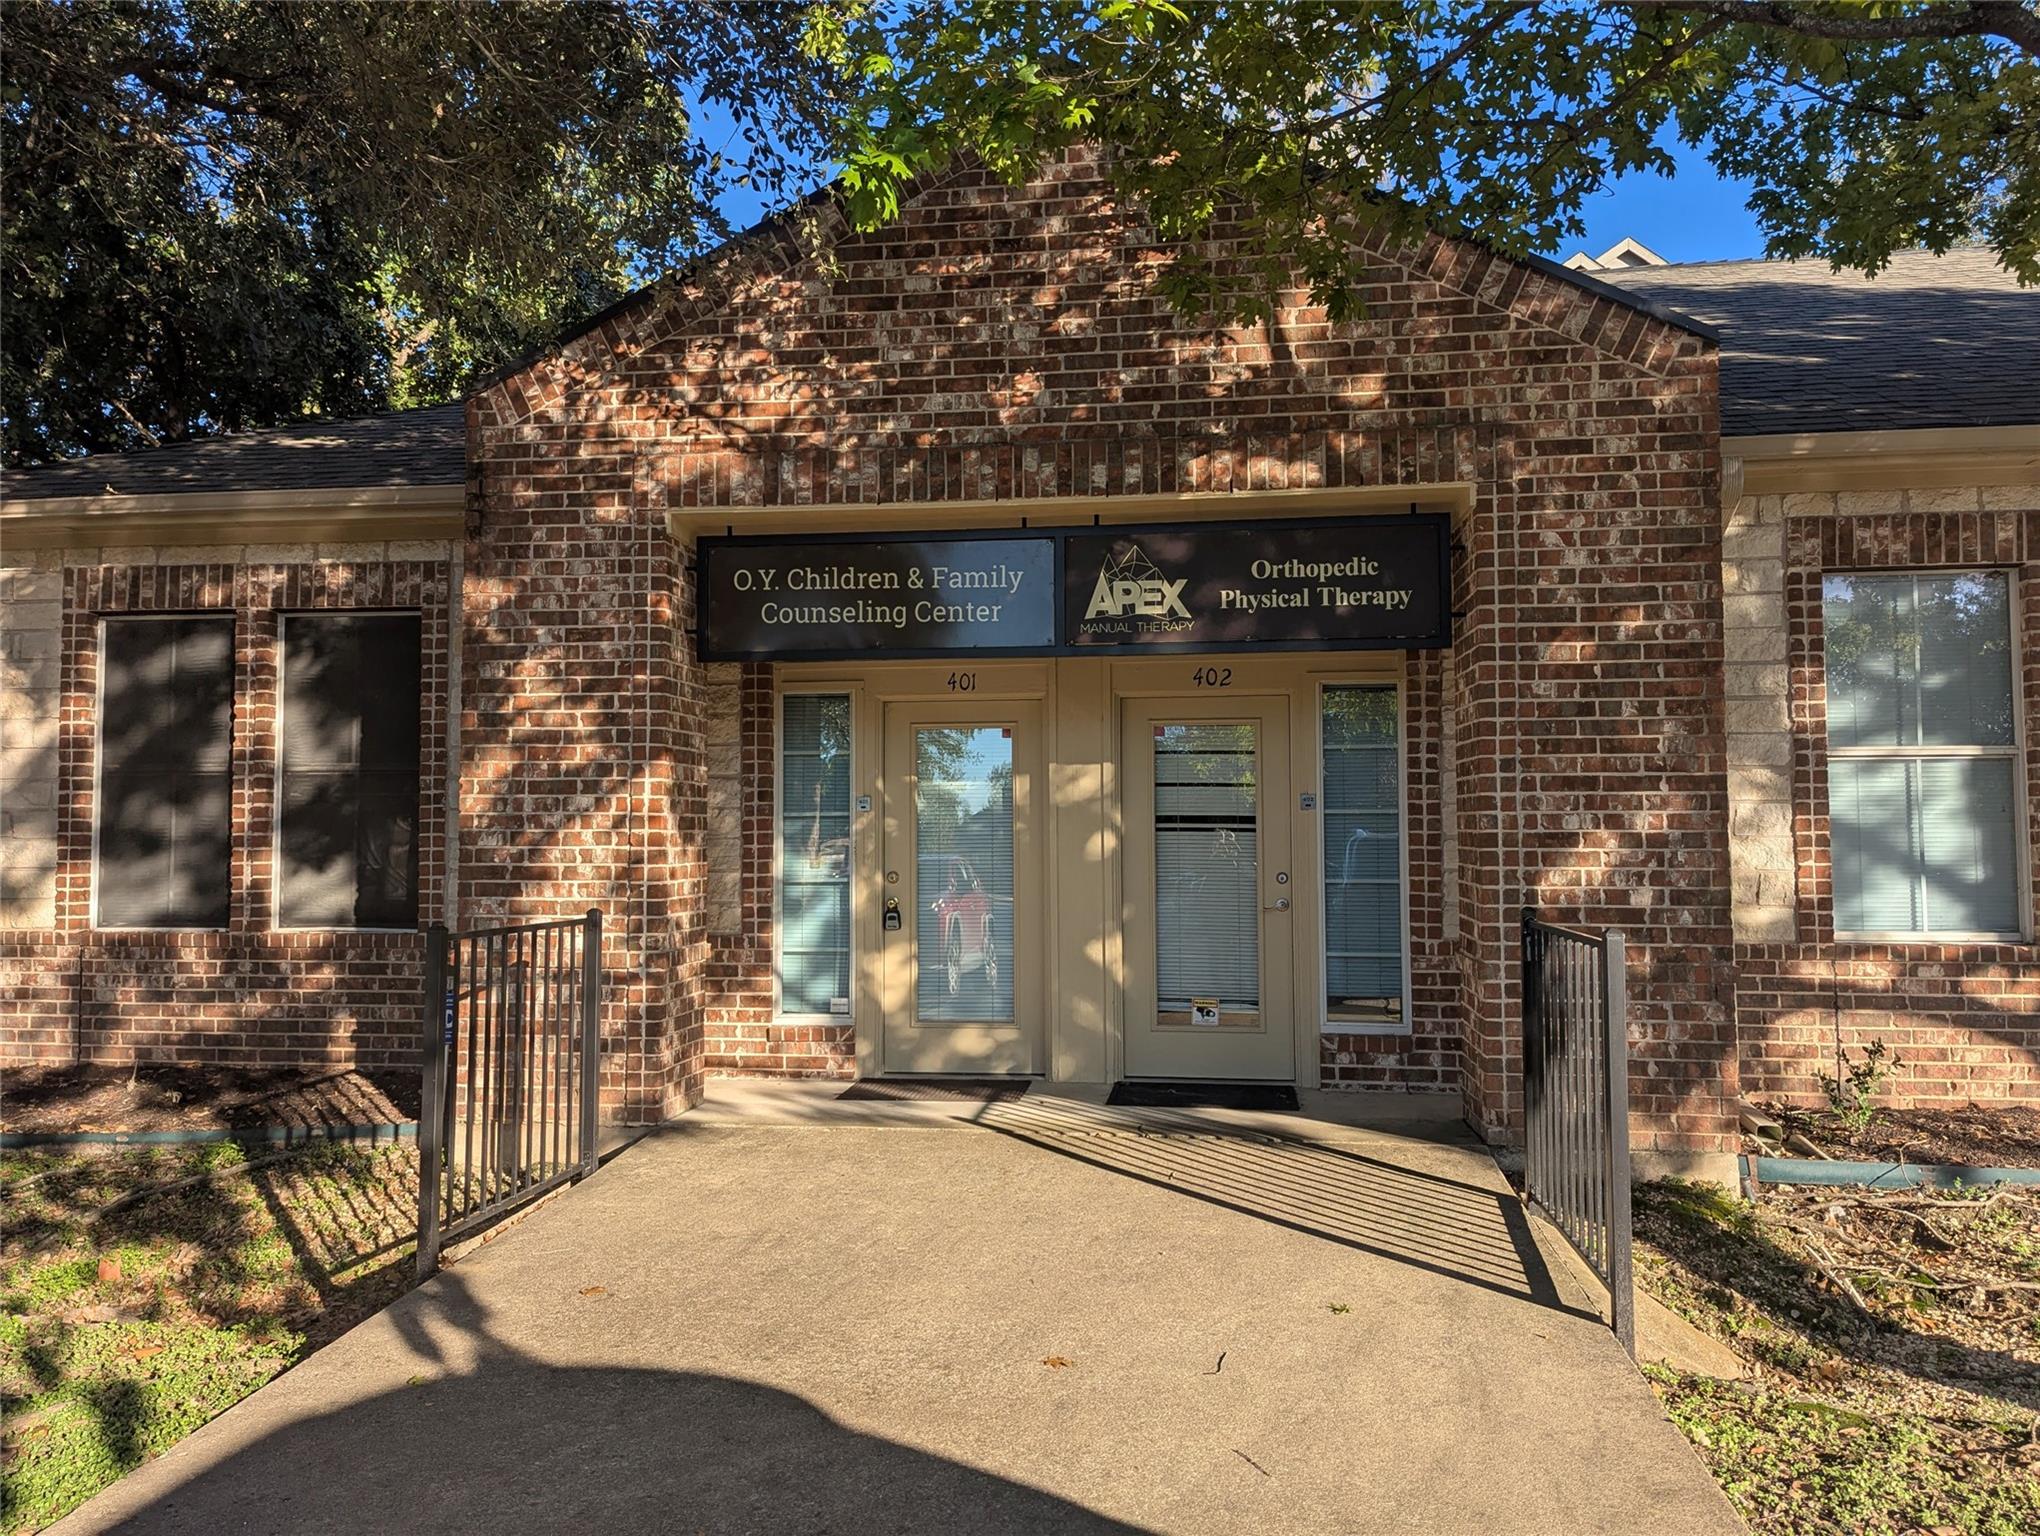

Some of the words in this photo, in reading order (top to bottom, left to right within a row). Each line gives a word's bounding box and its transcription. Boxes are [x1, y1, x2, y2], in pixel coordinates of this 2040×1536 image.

[733, 568, 779, 591] O.Y.
[787, 566, 900, 591] Children
[907, 567, 924, 588] &
[932, 565, 1024, 593] Family
[1251, 556, 1379, 582] Orthopedic
[1084, 571, 1192, 620] APEX
[1220, 587, 1309, 614] Physical
[1317, 586, 1412, 611] Therapy
[761, 600, 906, 628] Counseling
[914, 600, 1001, 623] Center
[1080, 622, 1132, 634] MANUAL
[1137, 620, 1195, 633] THERAPY
[947, 672, 976, 691] 401
[1193, 667, 1232, 688] 402
